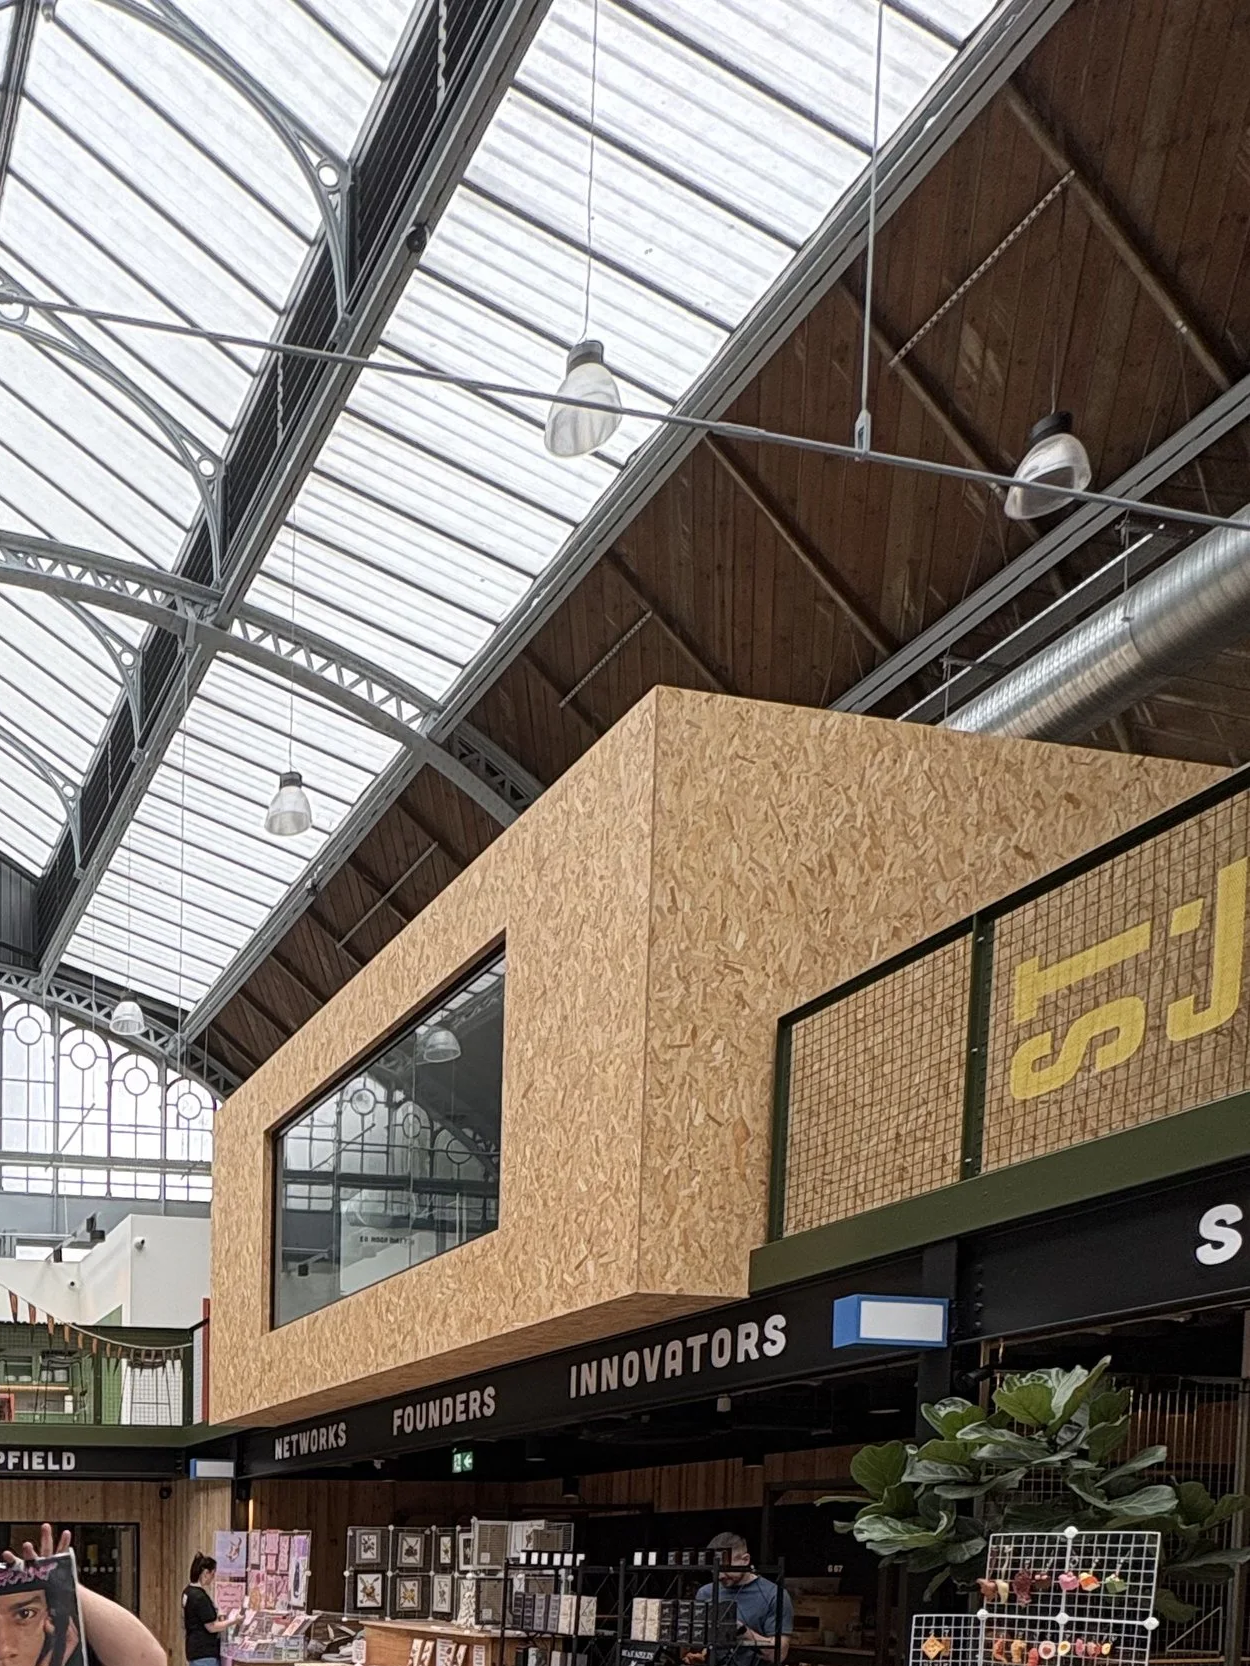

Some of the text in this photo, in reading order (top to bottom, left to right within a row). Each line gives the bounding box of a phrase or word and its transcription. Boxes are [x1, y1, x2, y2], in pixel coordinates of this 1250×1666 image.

[569, 1314, 787, 1398] INNOVATORS
[393, 1386, 496, 1435] FOUNDERS
[274, 1421, 347, 1459] NETWORKS
